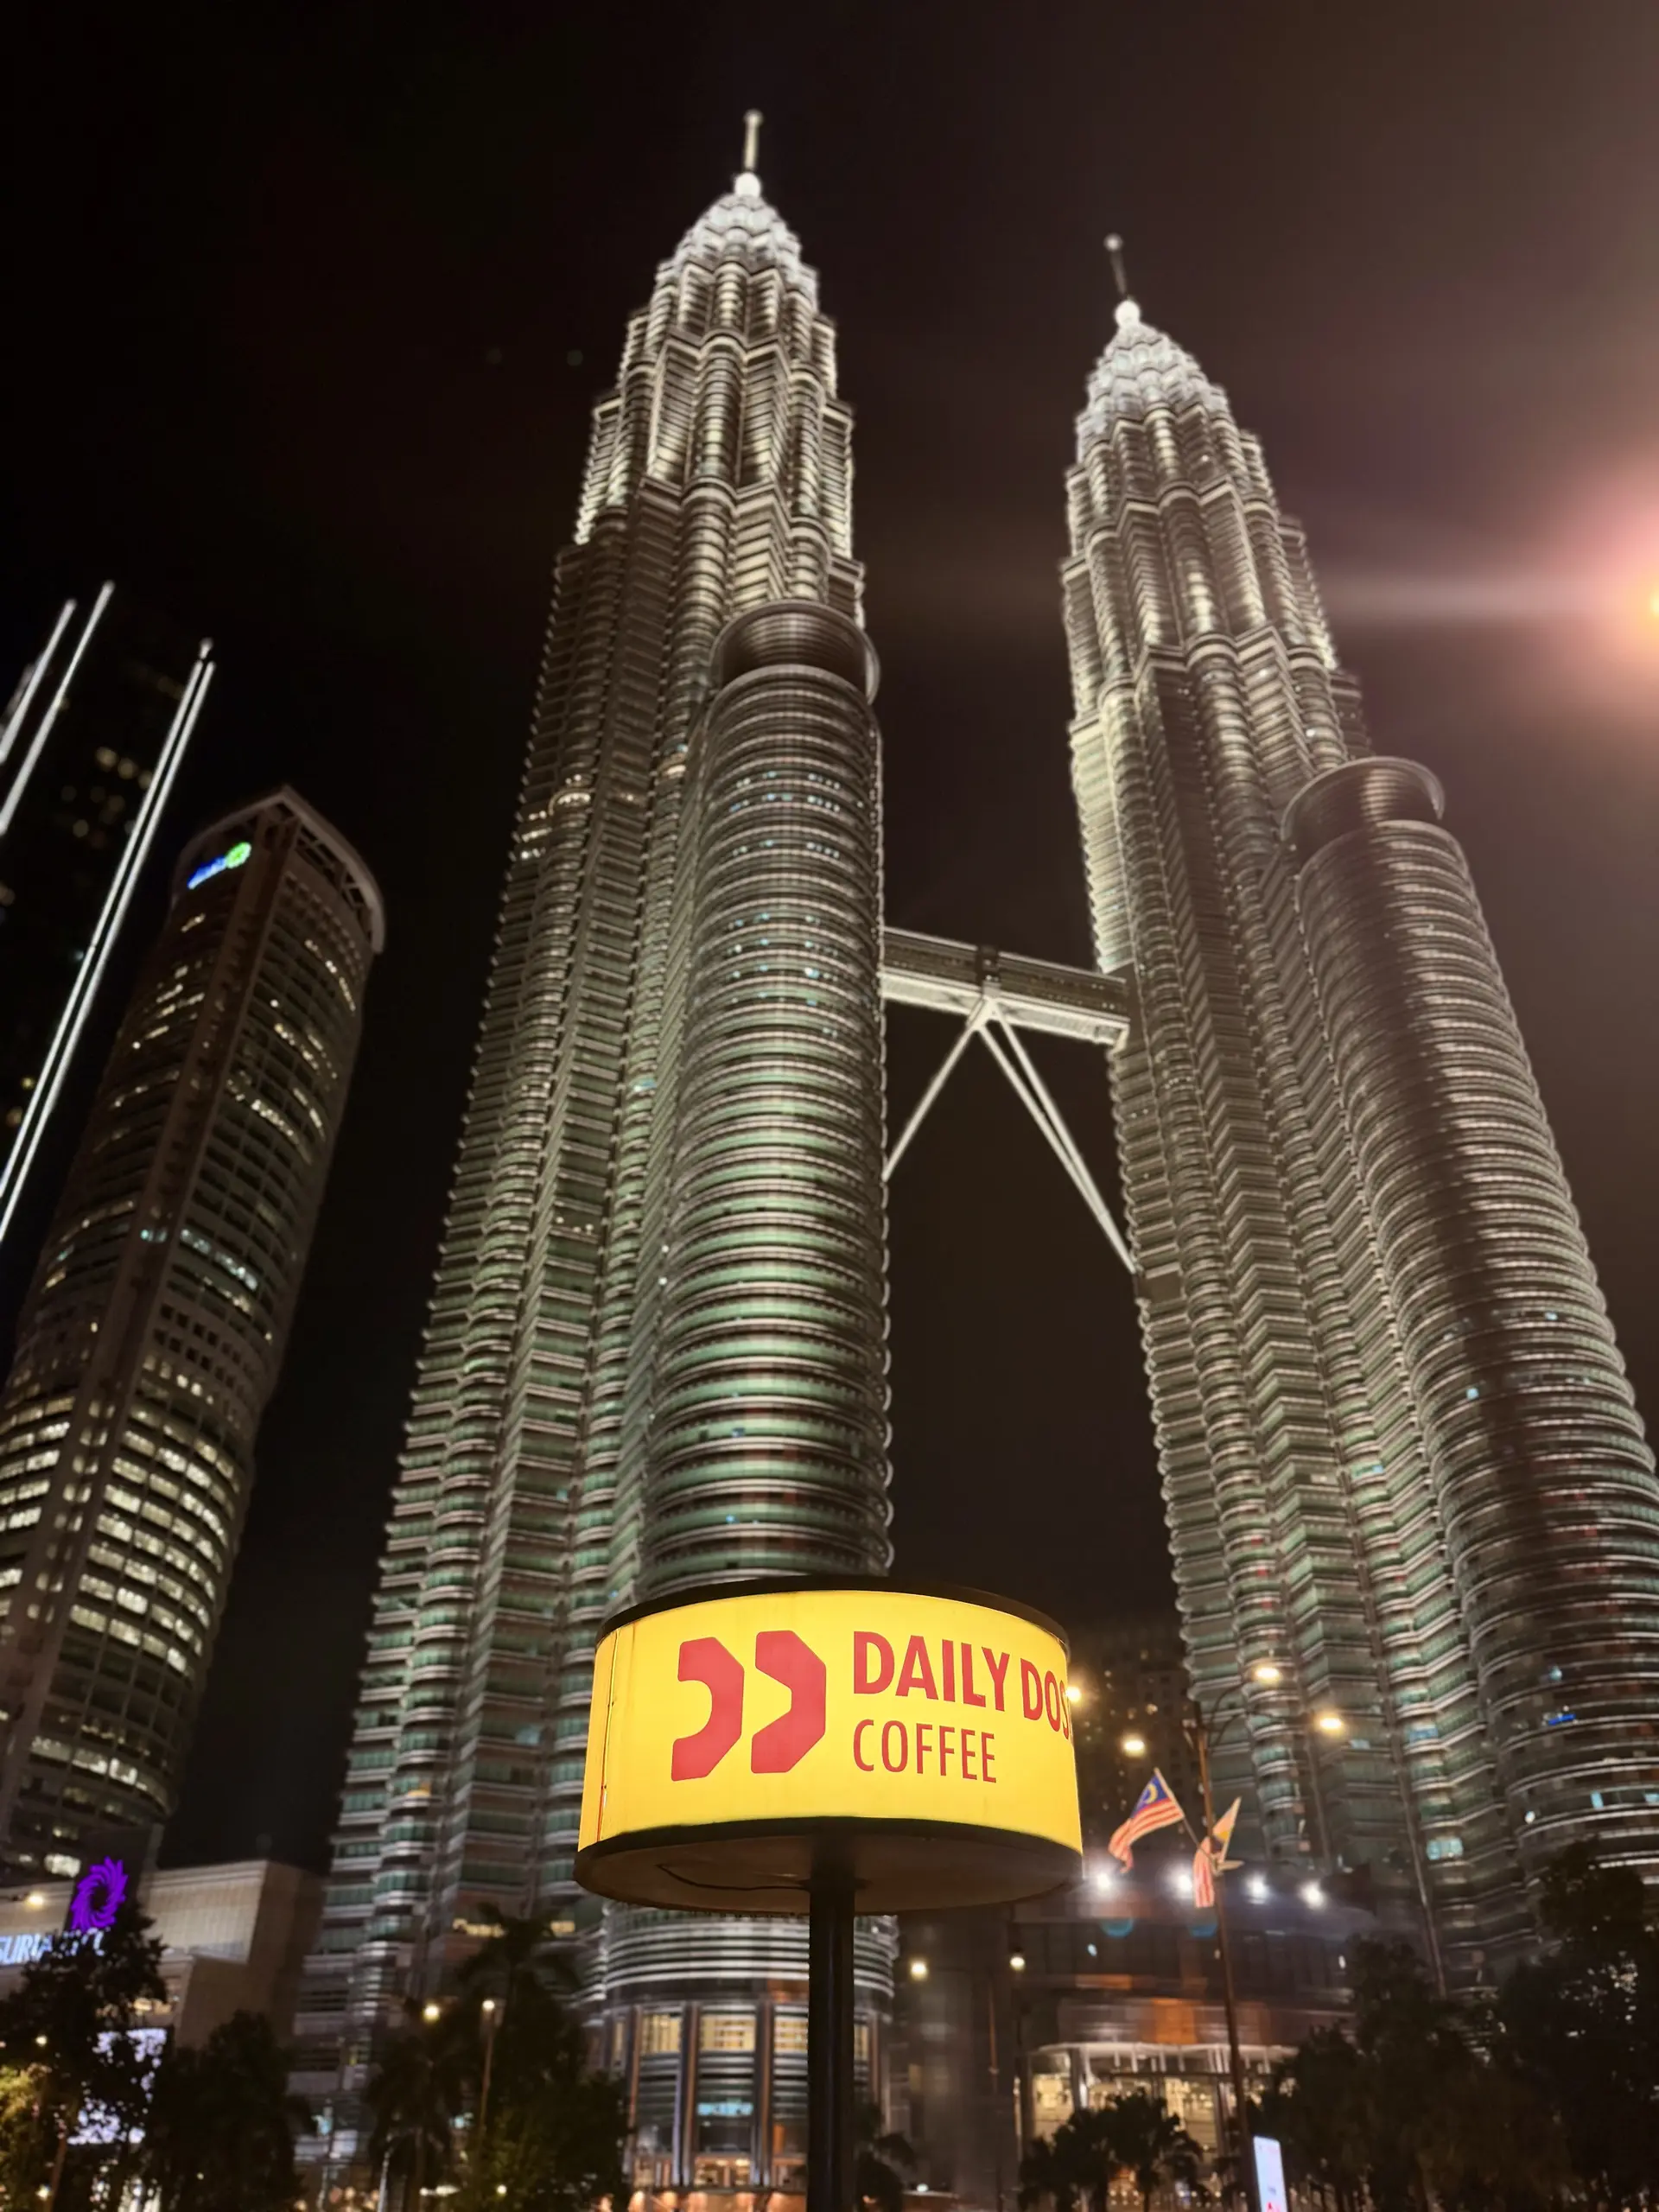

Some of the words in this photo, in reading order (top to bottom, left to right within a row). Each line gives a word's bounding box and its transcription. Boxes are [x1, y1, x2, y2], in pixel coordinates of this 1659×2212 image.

[853, 1630, 1010, 1712] DAILY
[1020, 1657, 1071, 1740] DOS
[853, 1719, 996, 1783] COFFEE
